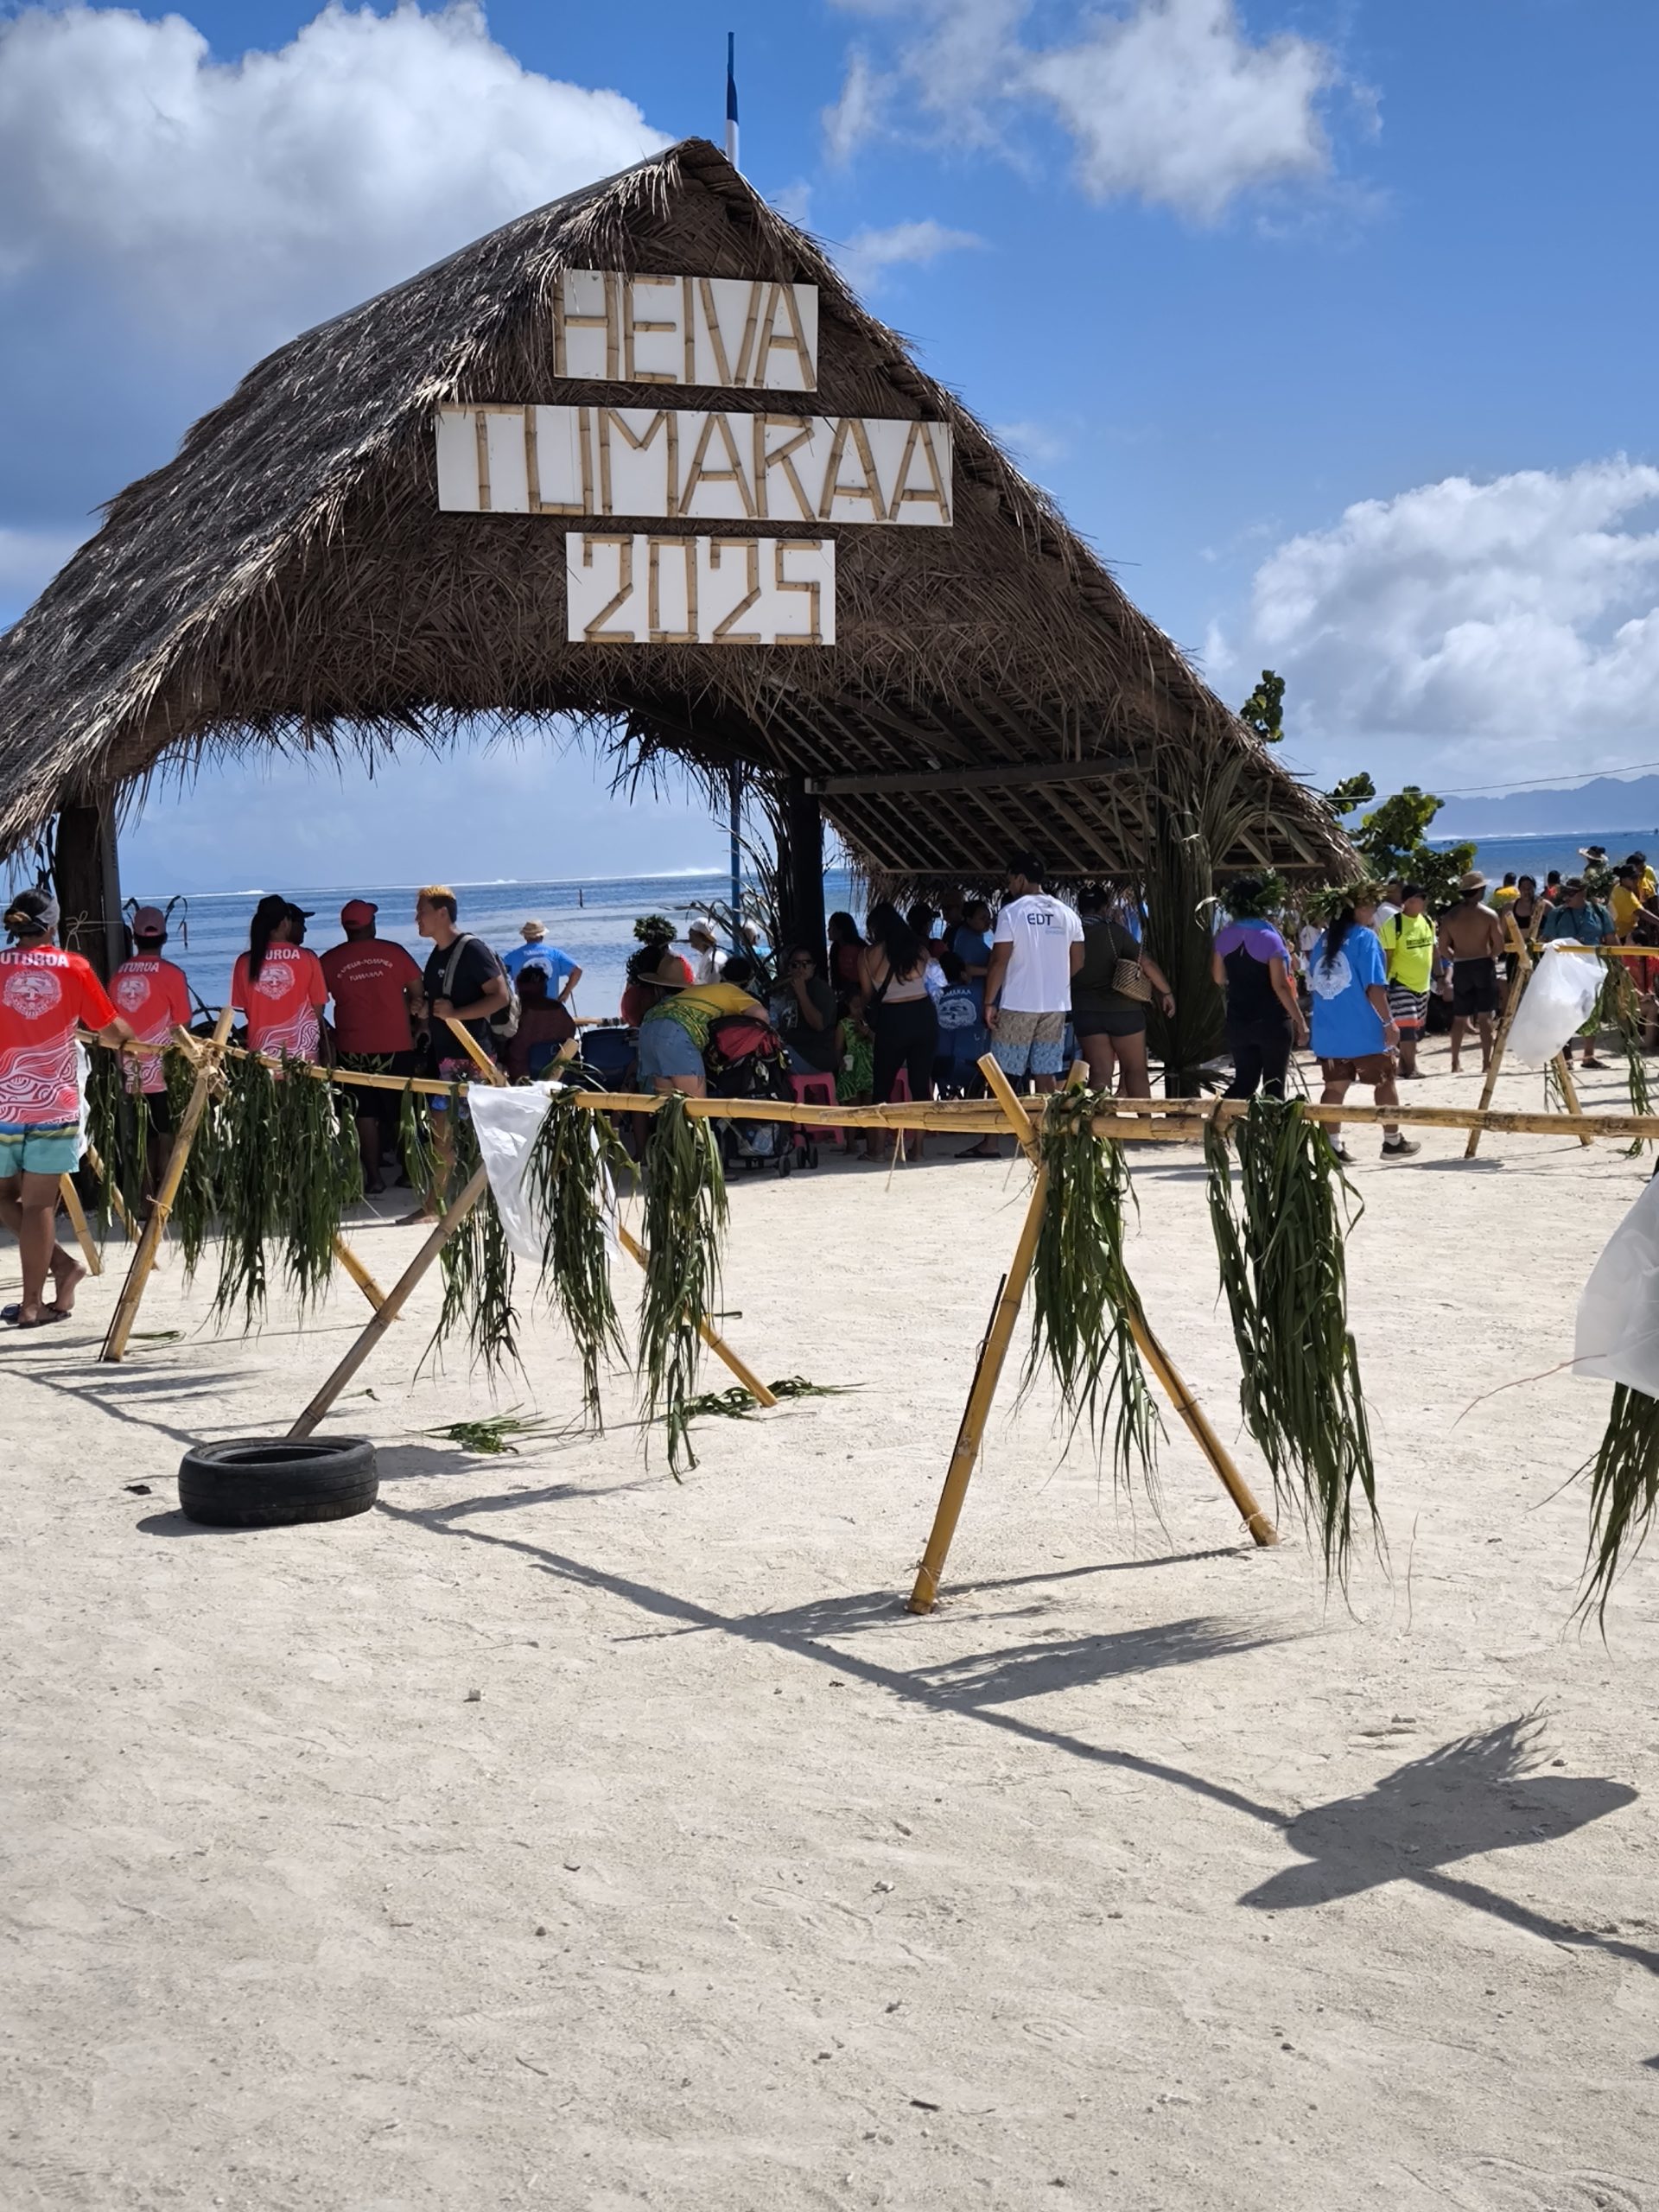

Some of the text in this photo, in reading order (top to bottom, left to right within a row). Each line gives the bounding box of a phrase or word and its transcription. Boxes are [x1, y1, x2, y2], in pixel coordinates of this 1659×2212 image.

[553, 269, 817, 391] HEIVA
[438, 403, 951, 524] TUMARAA
[582, 533, 823, 645] 2025
[265, 948, 301, 961] UROA
[1027, 912, 1054, 926] EDT
